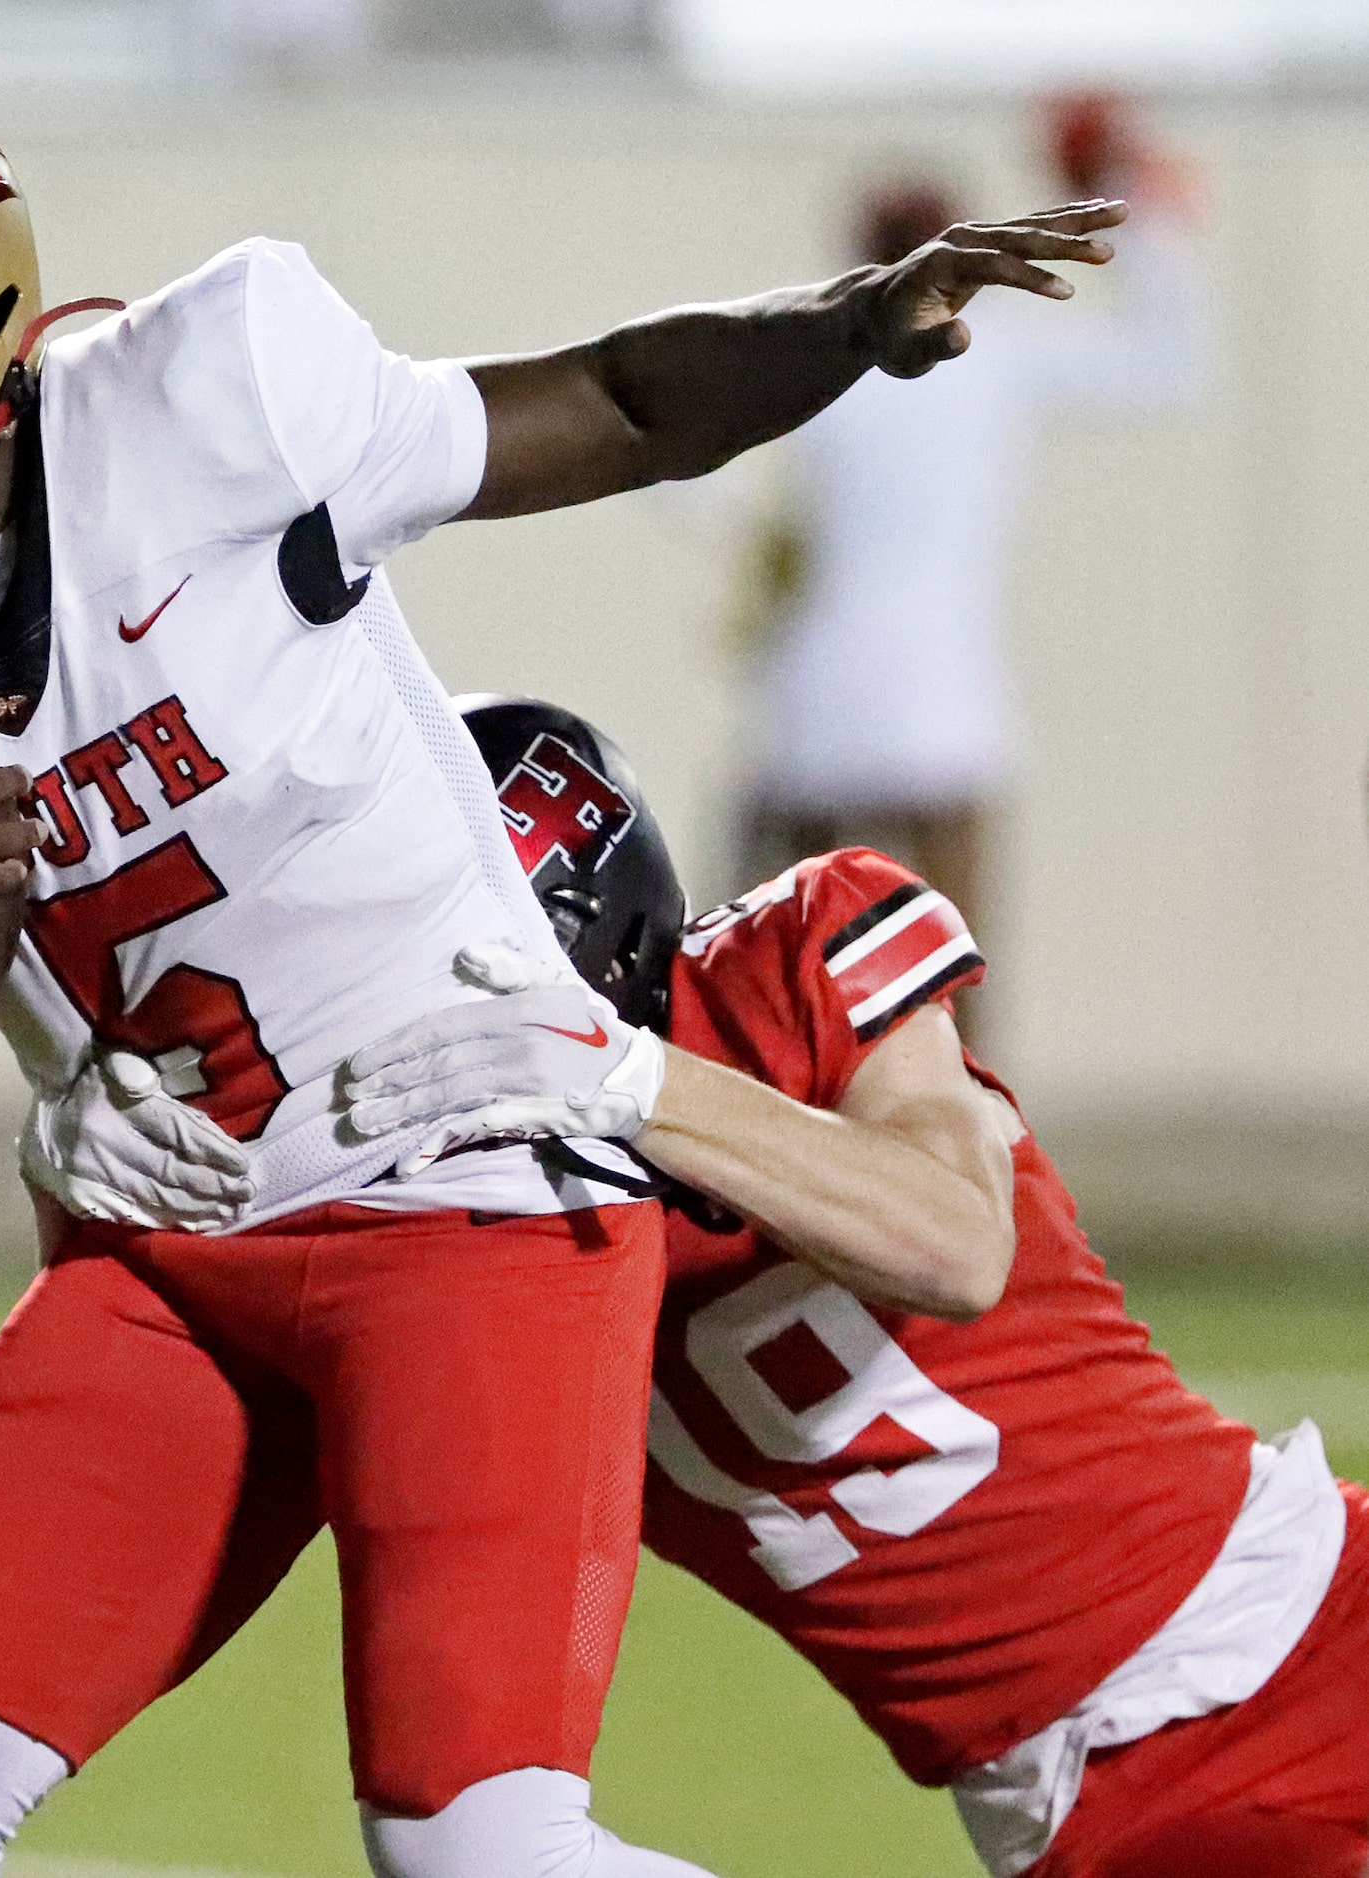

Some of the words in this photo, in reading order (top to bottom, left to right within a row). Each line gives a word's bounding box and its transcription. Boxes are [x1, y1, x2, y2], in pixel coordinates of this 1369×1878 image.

[18, 693, 230, 868] UTH
[25, 830, 292, 1143] 5
[646, 1260, 1000, 1592] 19
